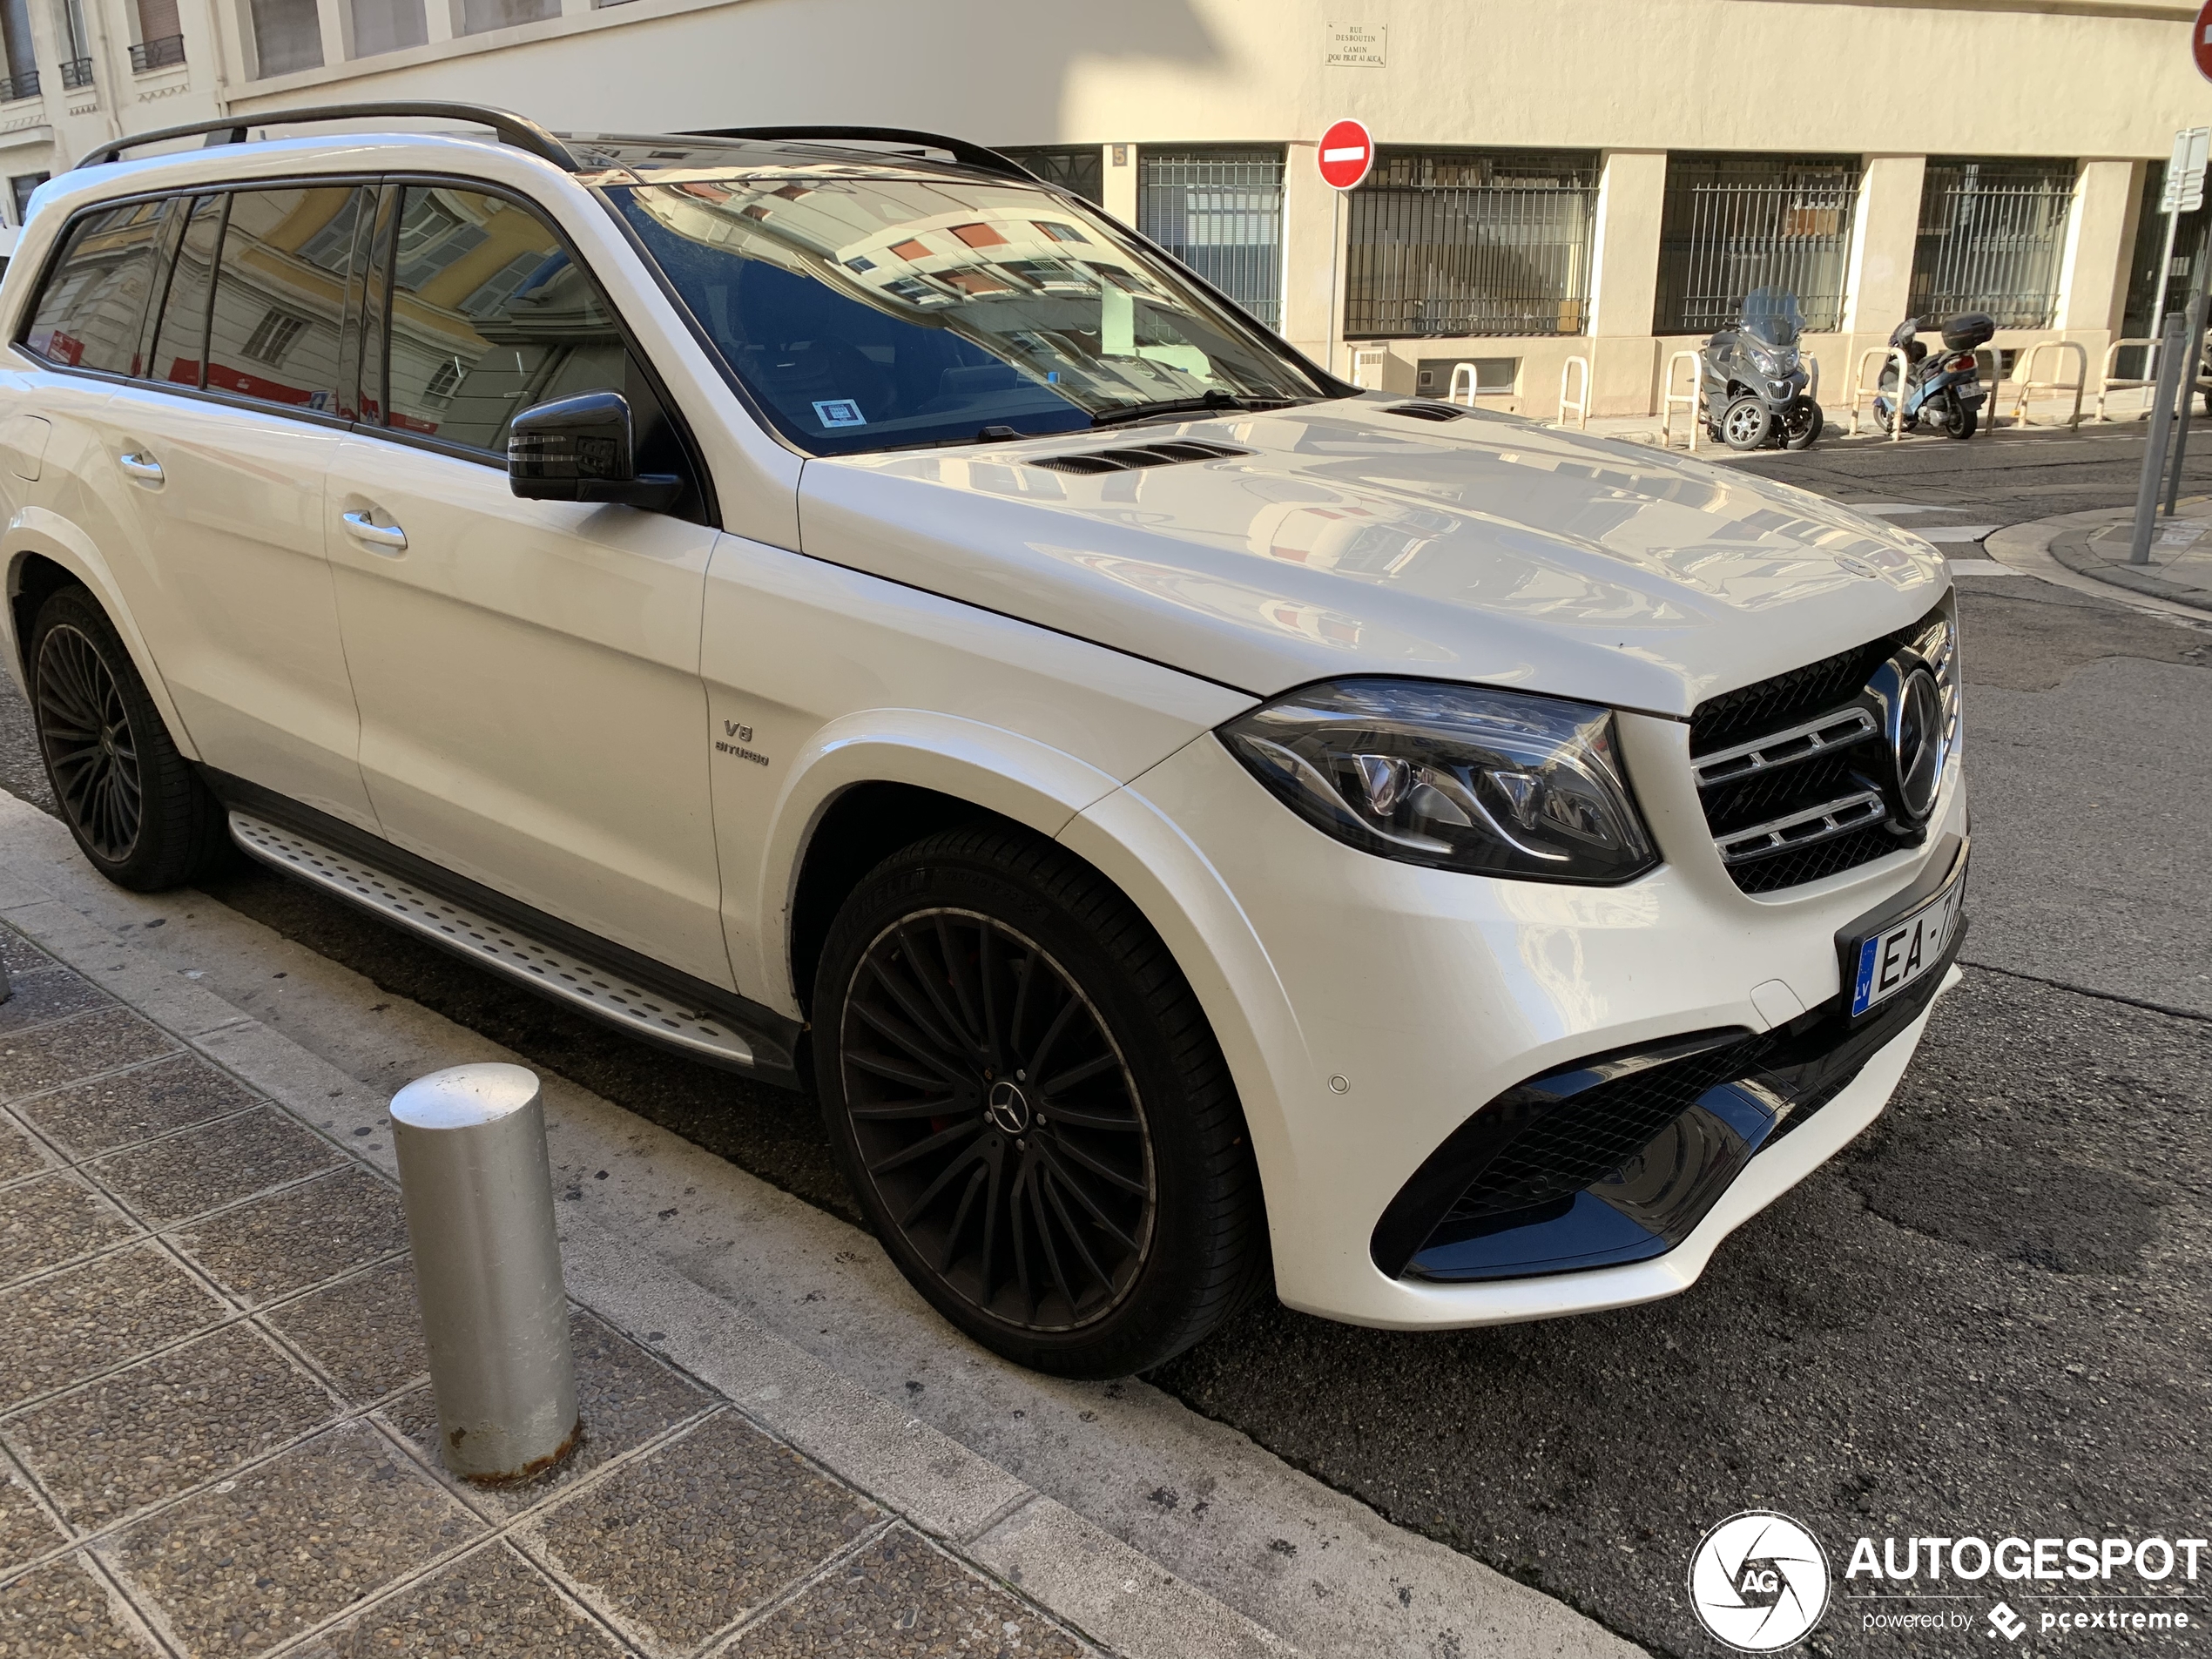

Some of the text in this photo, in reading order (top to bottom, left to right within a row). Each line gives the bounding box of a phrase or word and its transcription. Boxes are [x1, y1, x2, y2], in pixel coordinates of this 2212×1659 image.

[1114, 147, 1125, 164] 5
[724, 718, 753, 742] V8
[715, 740, 770, 766] BITURBO
[945, 871, 988, 888] 285/40
[1855, 980, 1870, 1001] LV
